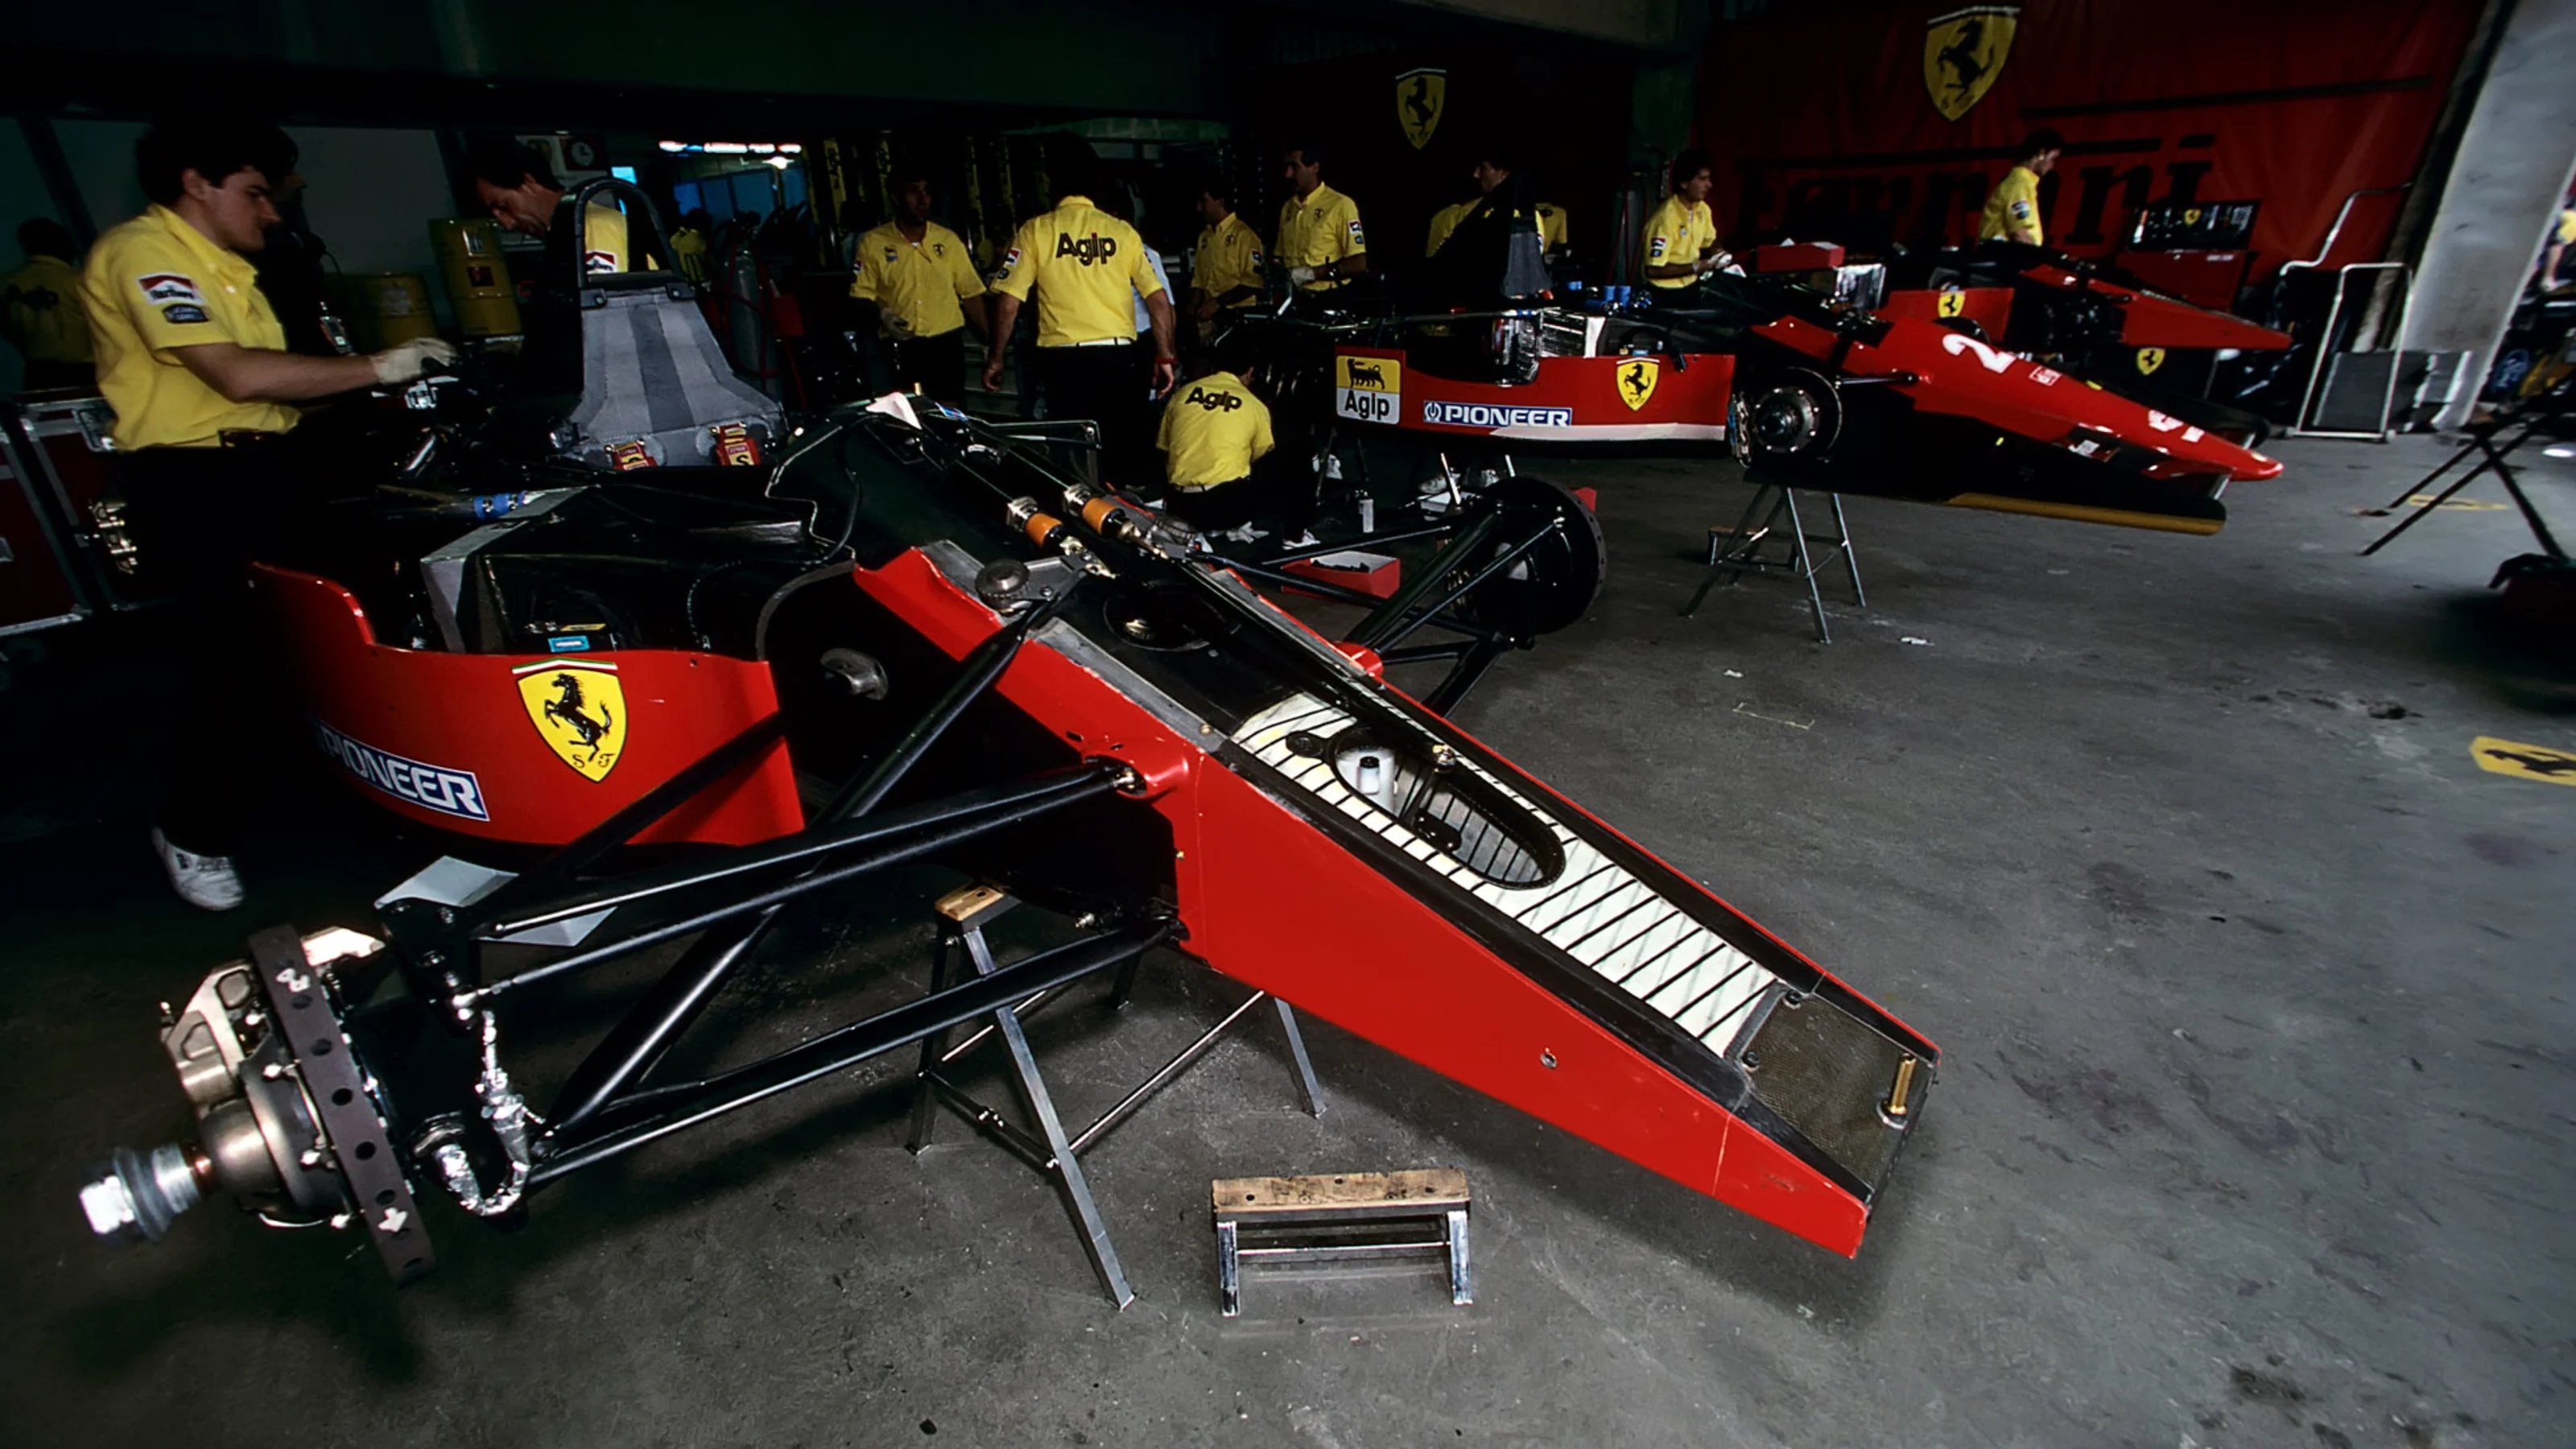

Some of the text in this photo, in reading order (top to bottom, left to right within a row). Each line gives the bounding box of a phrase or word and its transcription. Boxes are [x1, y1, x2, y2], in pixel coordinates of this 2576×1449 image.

[1055, 233, 1117, 266] Agip
[1185, 386, 1242, 412] Agip
[1344, 390, 1389, 420] Agip
[1444, 404, 1571, 427] PIONEER
[320, 724, 485, 815] PIONEER
